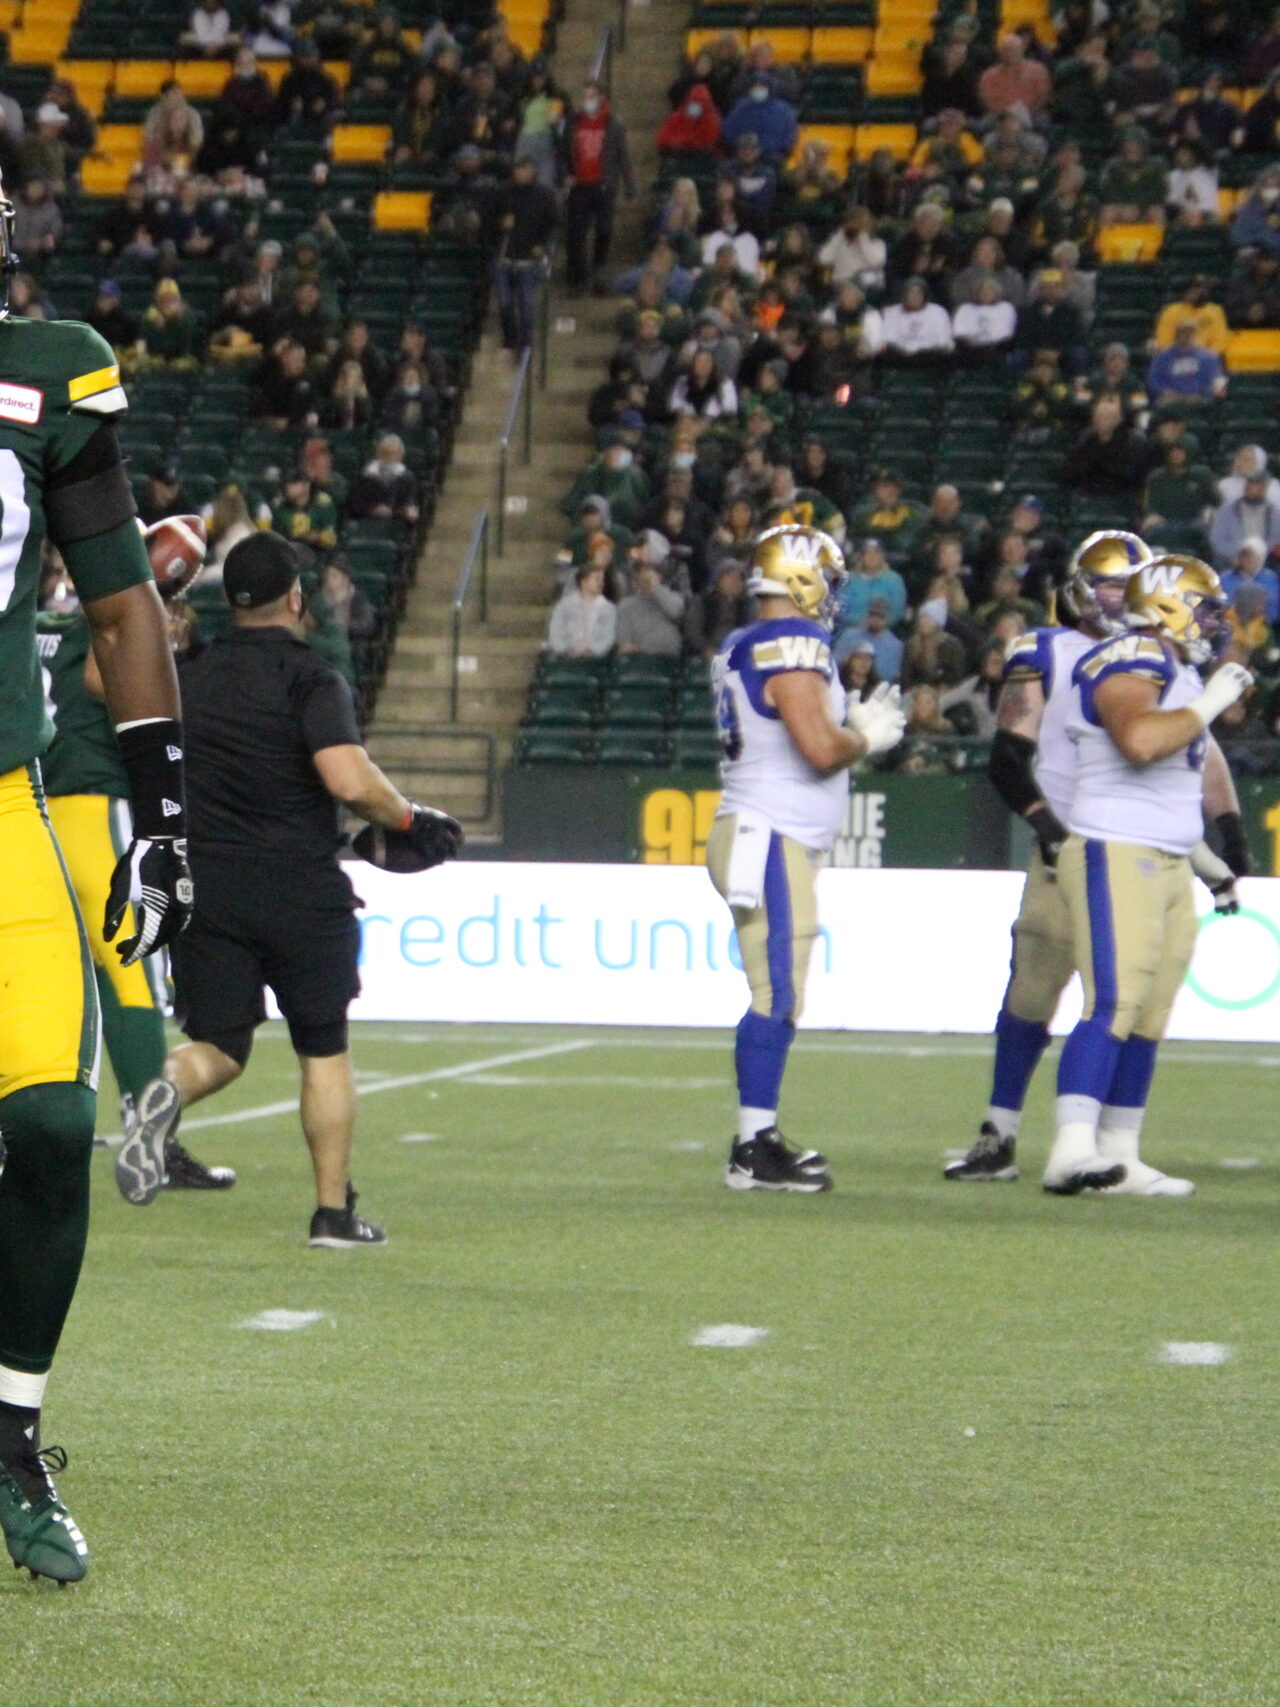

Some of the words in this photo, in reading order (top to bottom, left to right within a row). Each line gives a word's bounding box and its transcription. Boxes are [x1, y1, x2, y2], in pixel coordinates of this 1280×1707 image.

[781, 534, 821, 567] W
[1142, 565, 1184, 595] W
[777, 635, 822, 669] W
[358, 894, 565, 970] redit
